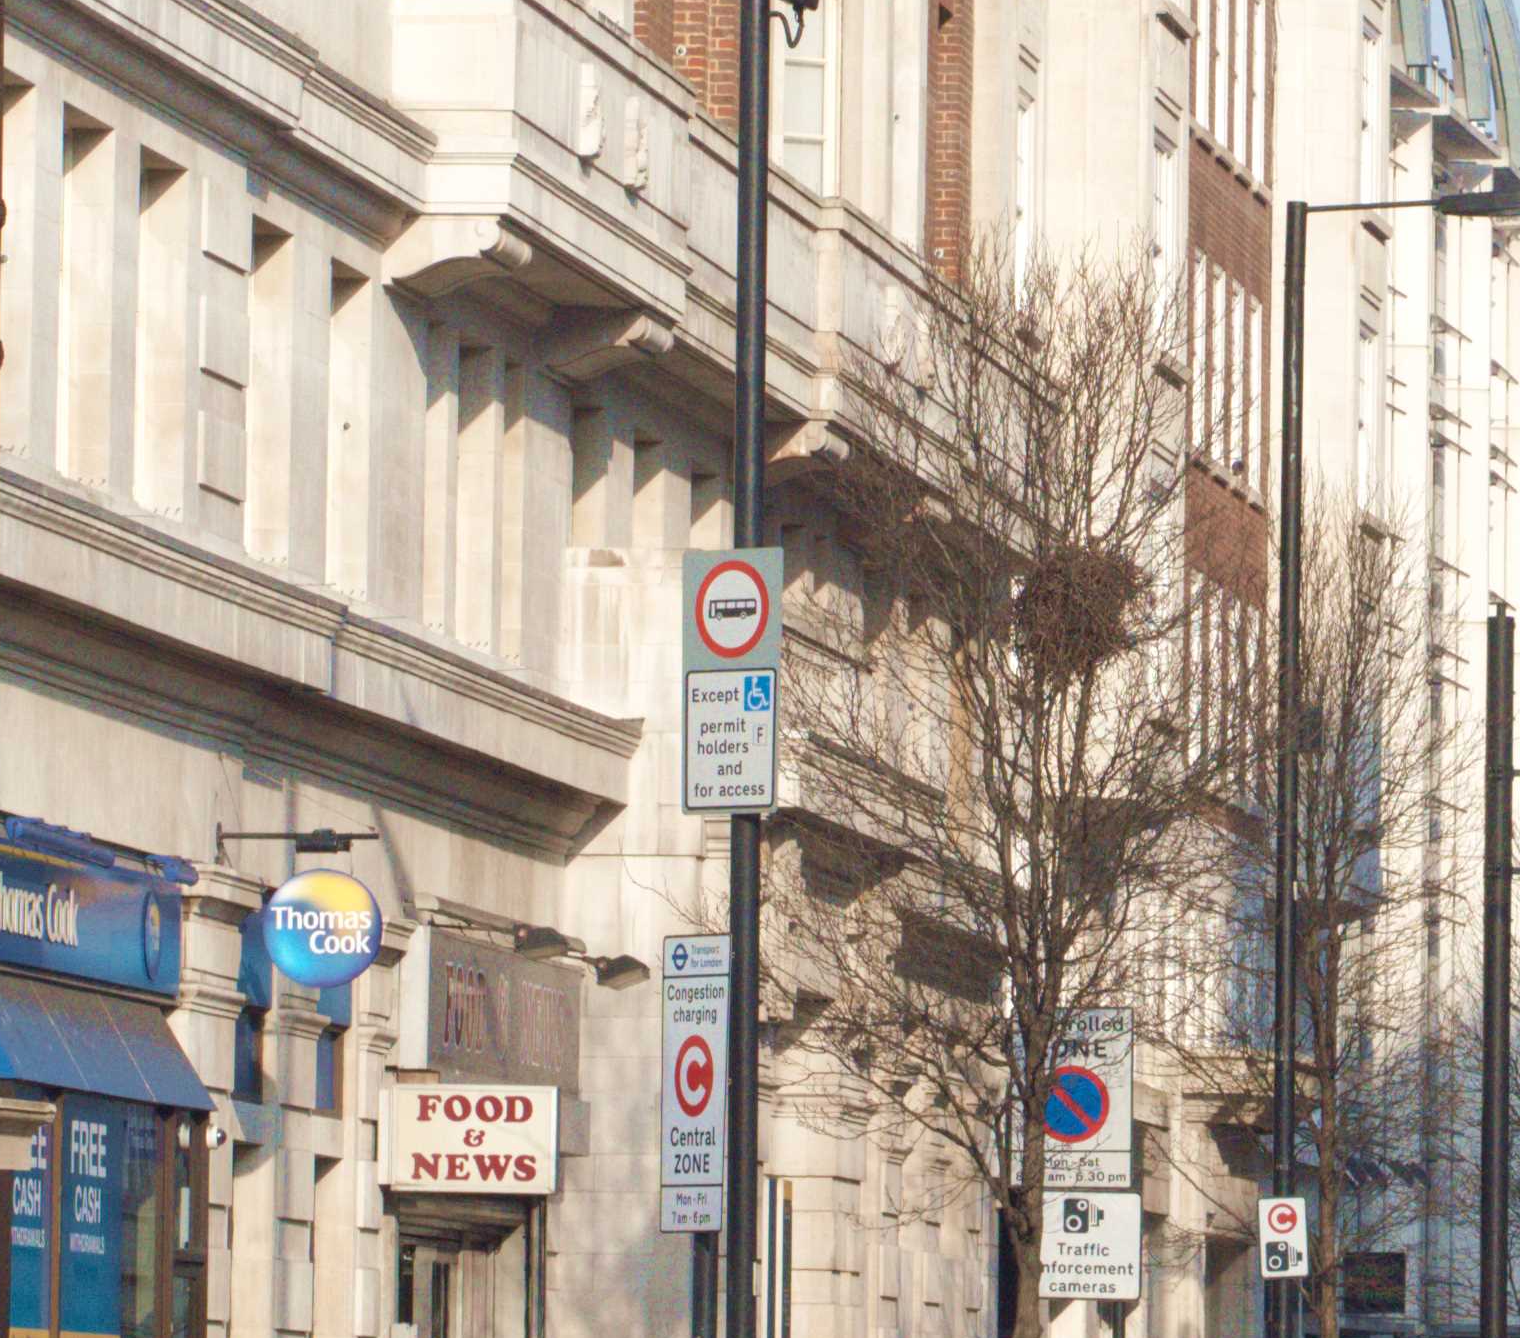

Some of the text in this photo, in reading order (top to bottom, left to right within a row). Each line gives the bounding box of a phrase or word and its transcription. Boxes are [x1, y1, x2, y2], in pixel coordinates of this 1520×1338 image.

[692, 687, 739, 704] Except
[700, 717, 747, 737] permit
[756, 726, 765, 744] F
[696, 740, 749, 755] holders
[717, 760, 743, 776] and
[694, 783, 766, 797] for access
[46, 883, 79, 948] Cook
[270, 906, 372, 930] Thomas
[309, 930, 372, 954] Cook
[691, 944, 721, 956] Transport
[691, 958, 724, 968] for London
[667, 984, 725, 1002] Congestion
[444, 961, 487, 1054] FOOD
[673, 1006, 717, 1025] charging
[416, 1094, 533, 1123] FOOD
[463, 1129, 486, 1147] &
[670, 1126, 716, 1147] Central
[71, 1119, 106, 1179] FREE
[411, 1153, 537, 1182] NEWS
[674, 1153, 711, 1174] ZONE
[1079, 1157, 1100, 1168] Sat
[1107, 1173, 1127, 1184] pm
[12, 1176, 42, 1217] CASH
[74, 1185, 101, 1224] CASH
[675, 1193, 692, 1206] Mon
[697, 1193, 708, 1206] Fri
[1057, 1242, 1111, 1256] Traffic
[1043, 1261, 1135, 1276] nforcement
[1049, 1282, 1117, 1294] cameras
